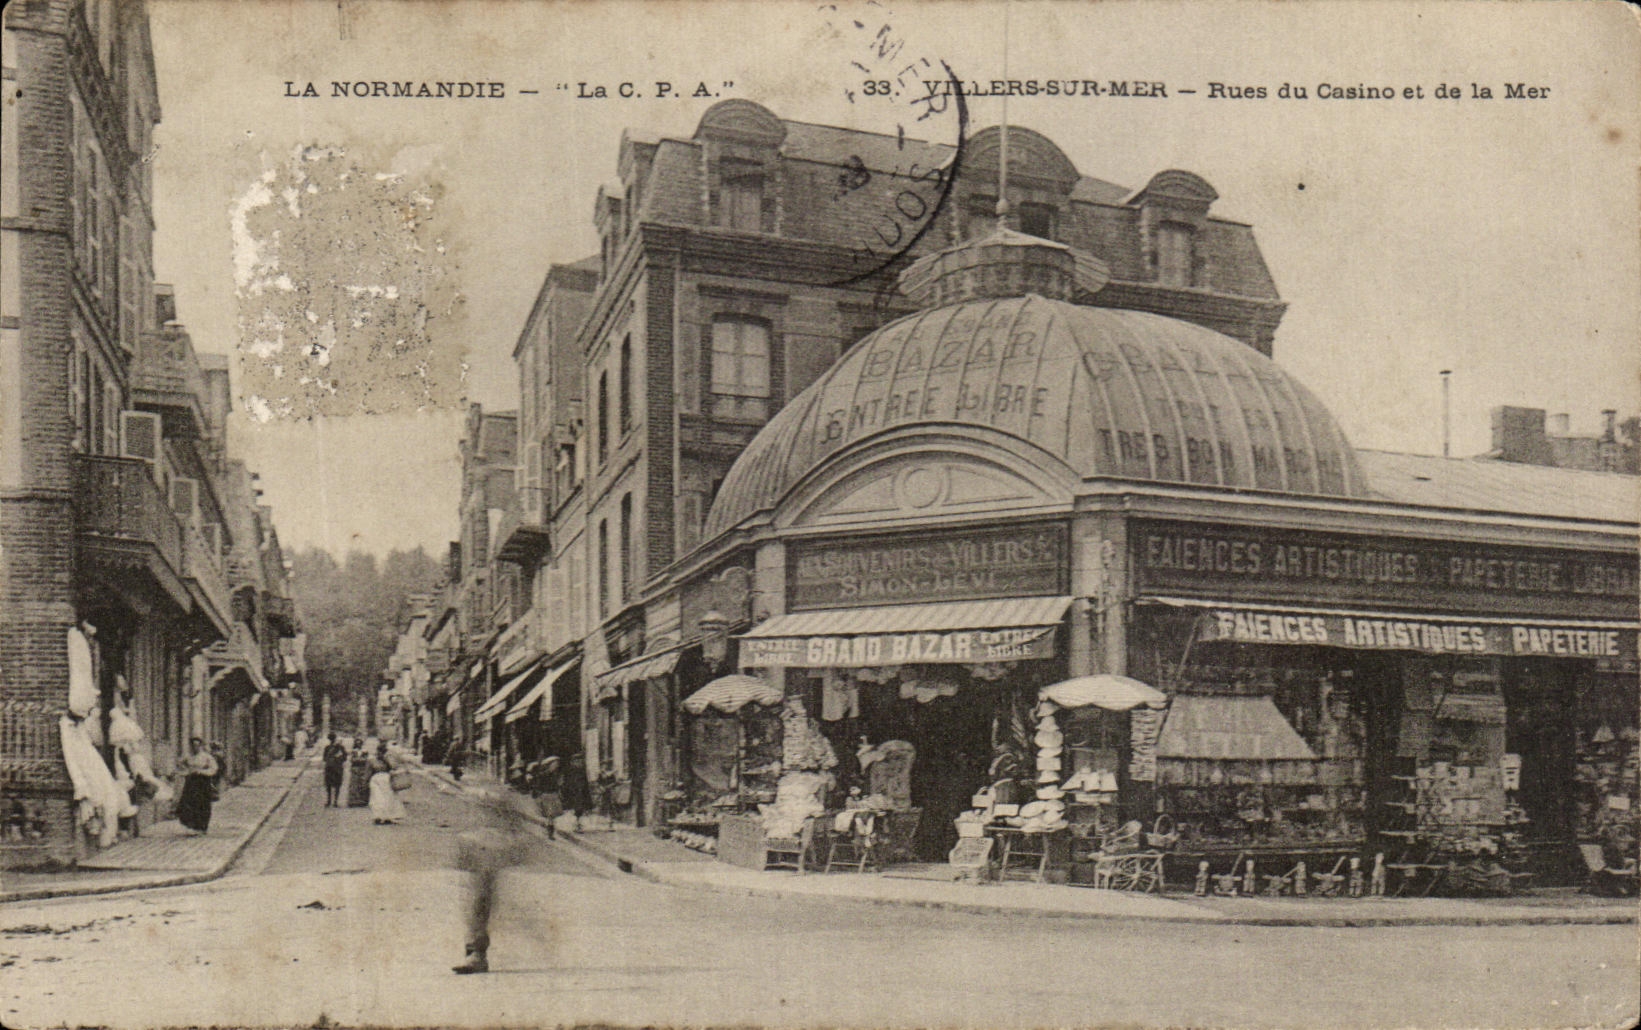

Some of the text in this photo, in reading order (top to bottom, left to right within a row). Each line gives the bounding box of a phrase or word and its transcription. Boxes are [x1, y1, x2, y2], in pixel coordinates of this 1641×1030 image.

[863, 330, 1038, 380] BAZAR
[806, 632, 972, 664] GRAND BAZAR
[1216, 611, 1619, 656] FAIENCES ARTISTIQUES PAPETERIE
